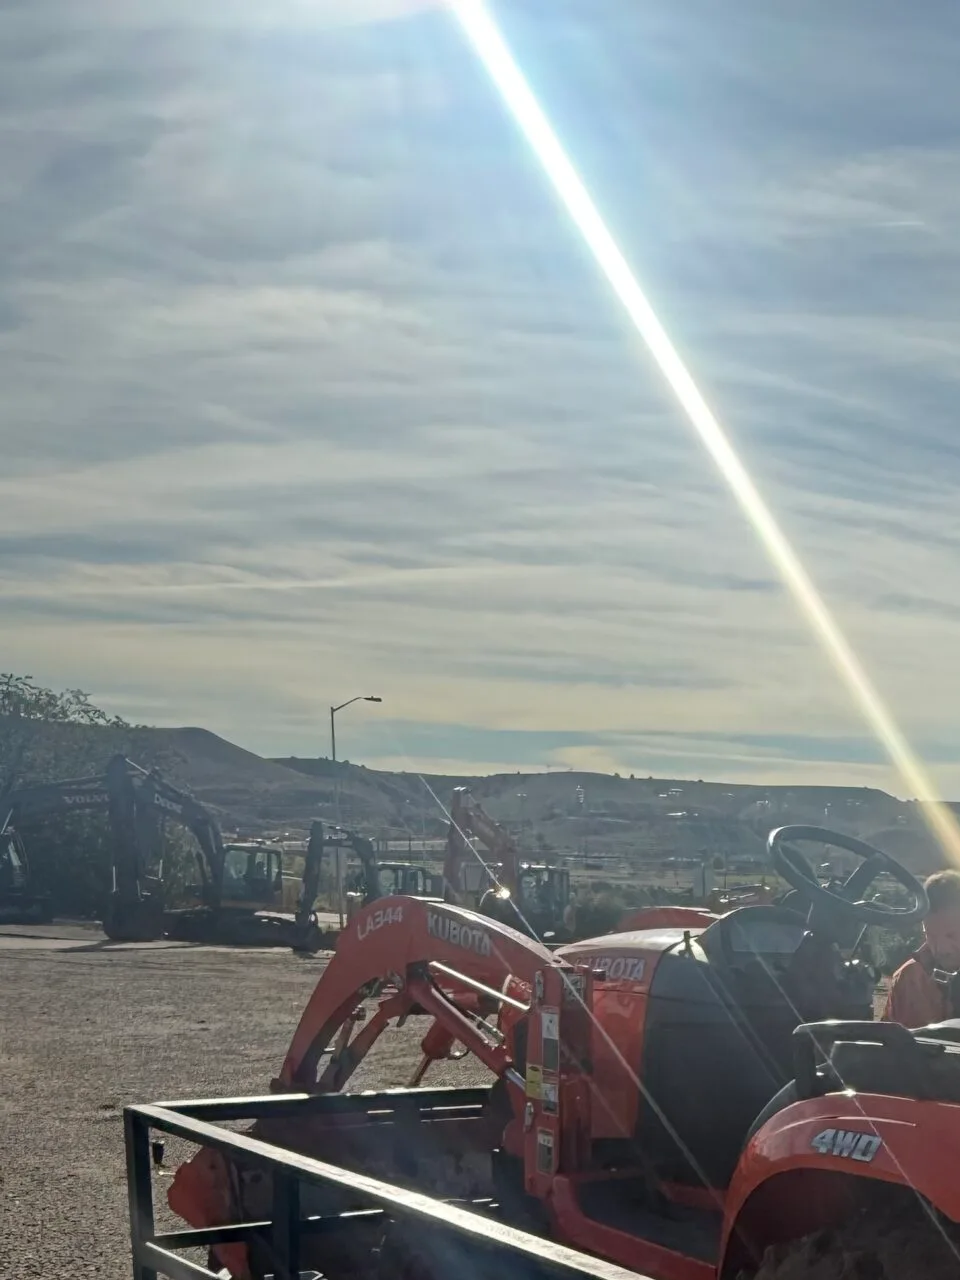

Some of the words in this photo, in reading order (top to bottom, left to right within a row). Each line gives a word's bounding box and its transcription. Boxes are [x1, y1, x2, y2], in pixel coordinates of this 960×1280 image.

[357, 906, 404, 941] LA344
[427, 911, 491, 958] KUBOTA
[811, 1128, 882, 1162] 4WD
